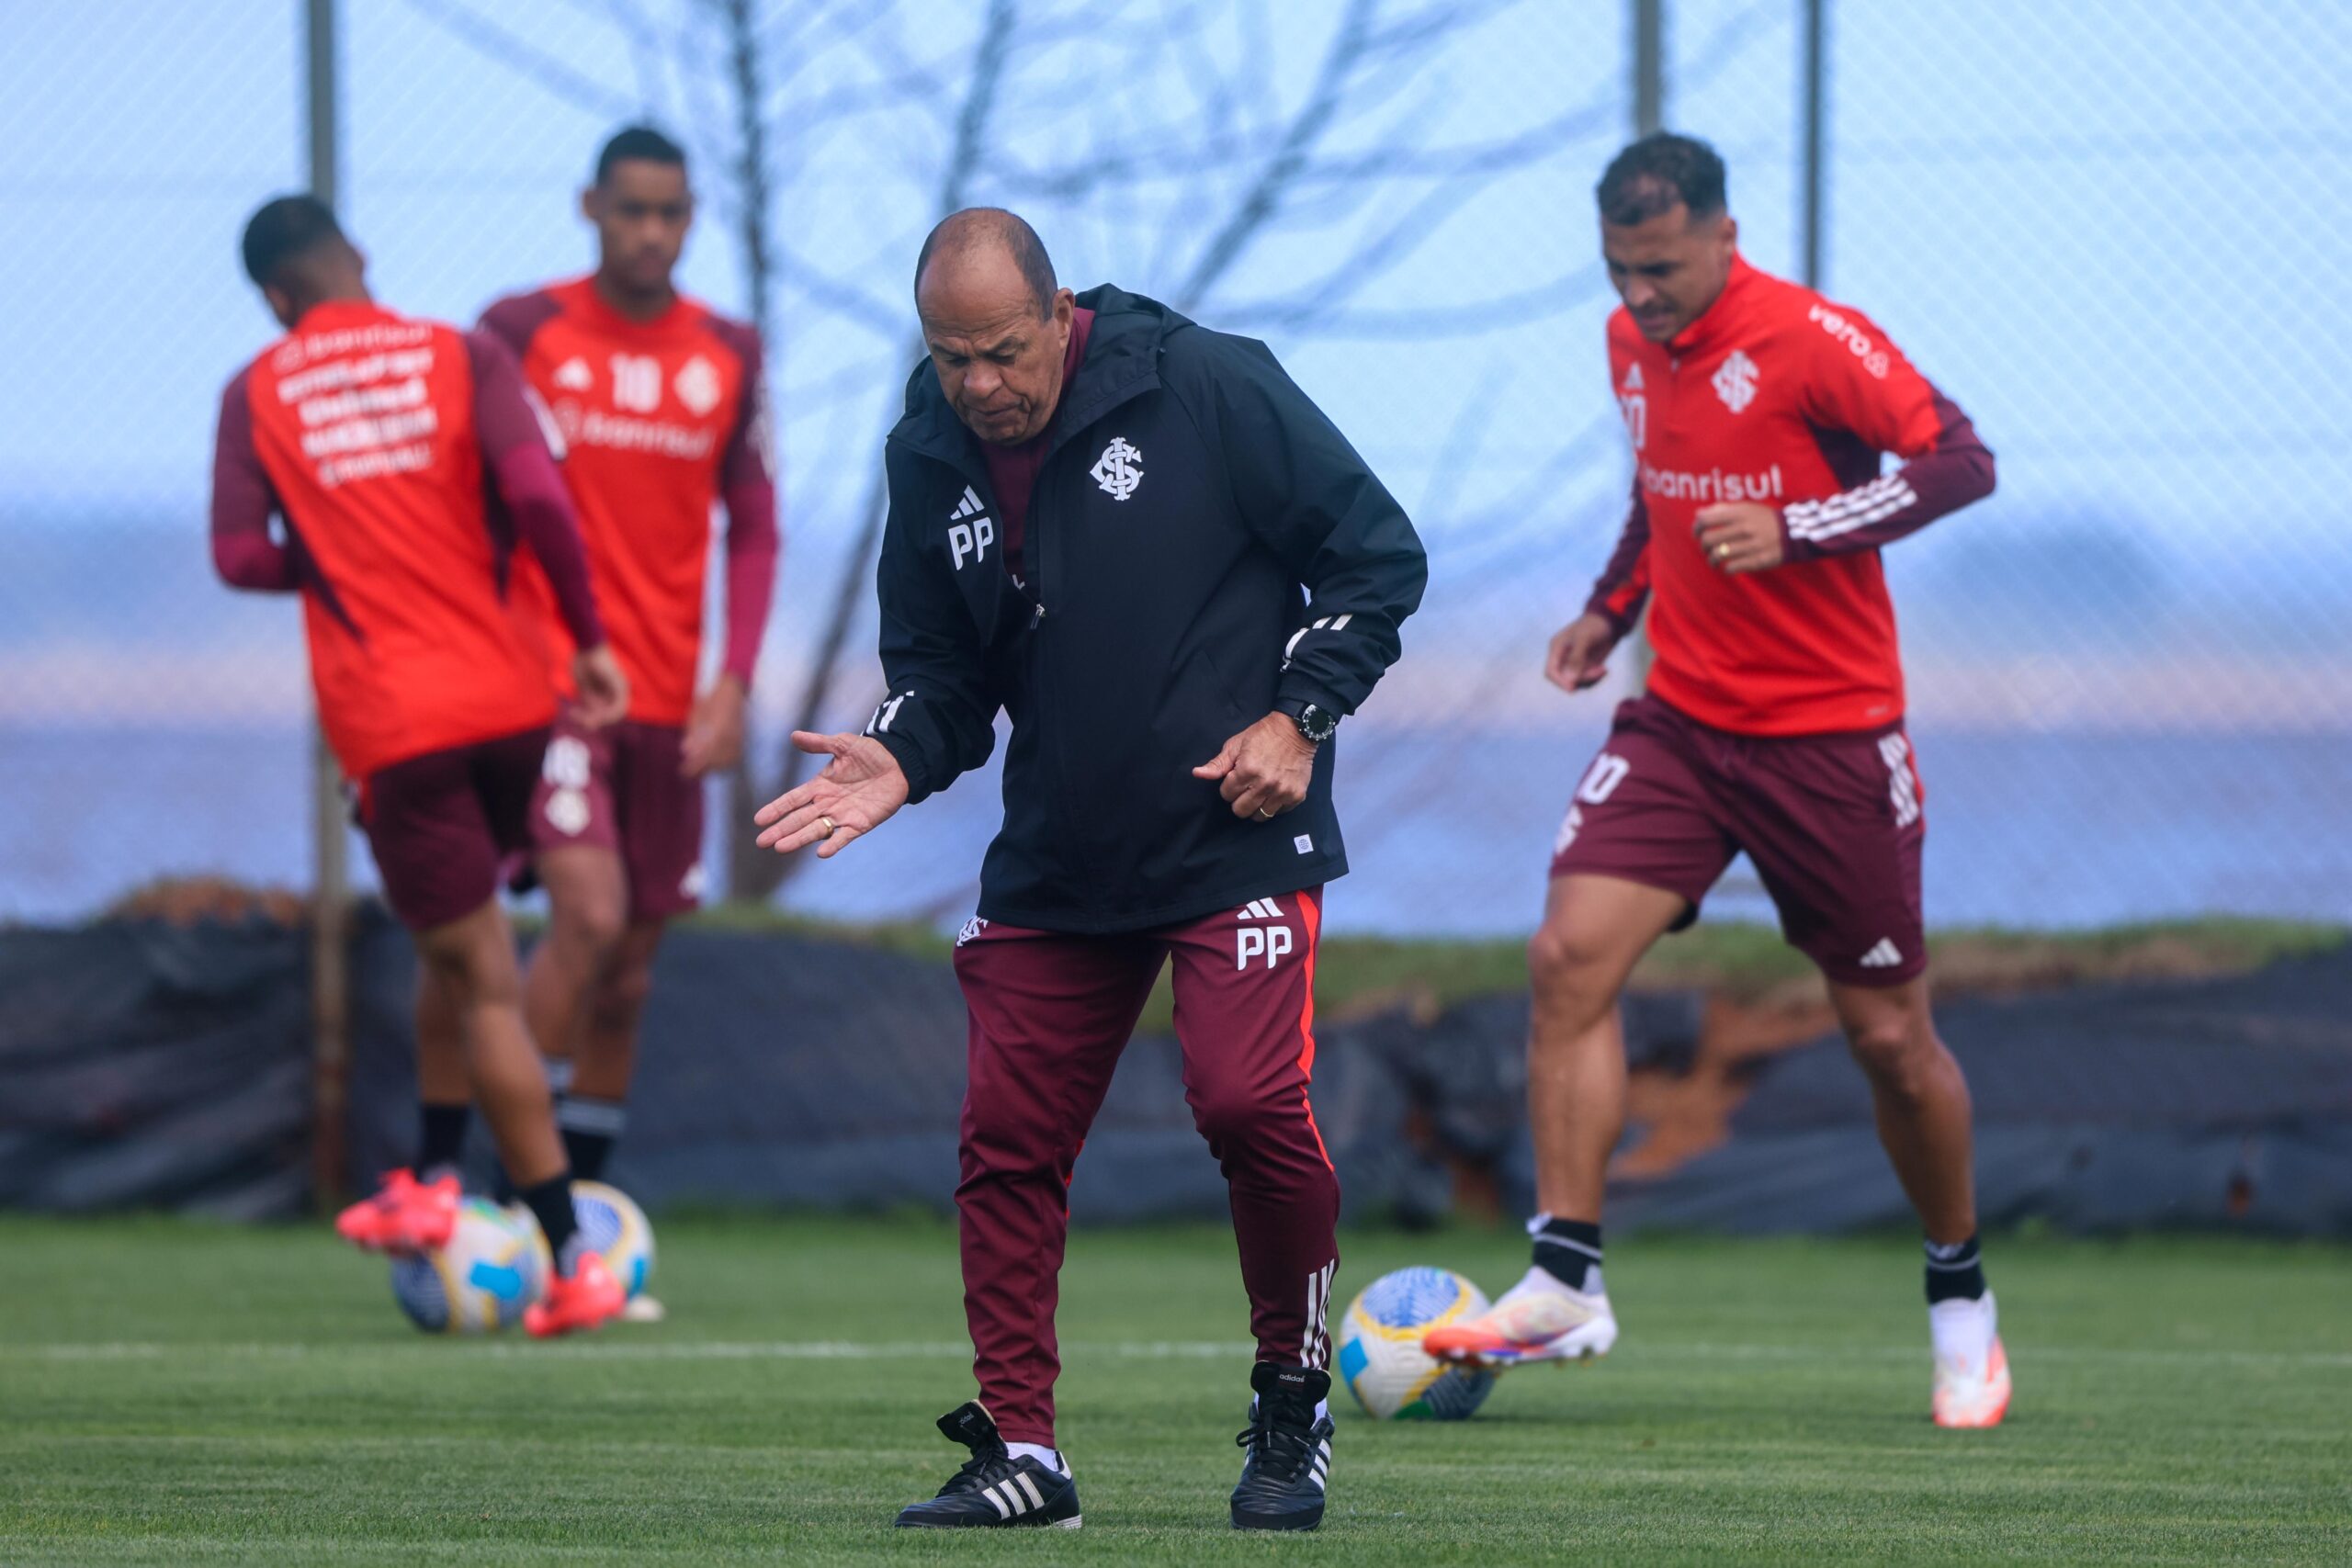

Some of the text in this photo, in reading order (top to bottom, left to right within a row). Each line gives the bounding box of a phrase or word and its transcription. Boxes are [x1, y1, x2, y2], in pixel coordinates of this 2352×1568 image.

[1807, 304, 1871, 357] vero
[948, 516, 994, 570] PP
[1237, 926, 1293, 971] PP
[1279, 1373, 1306, 1382] adidas
